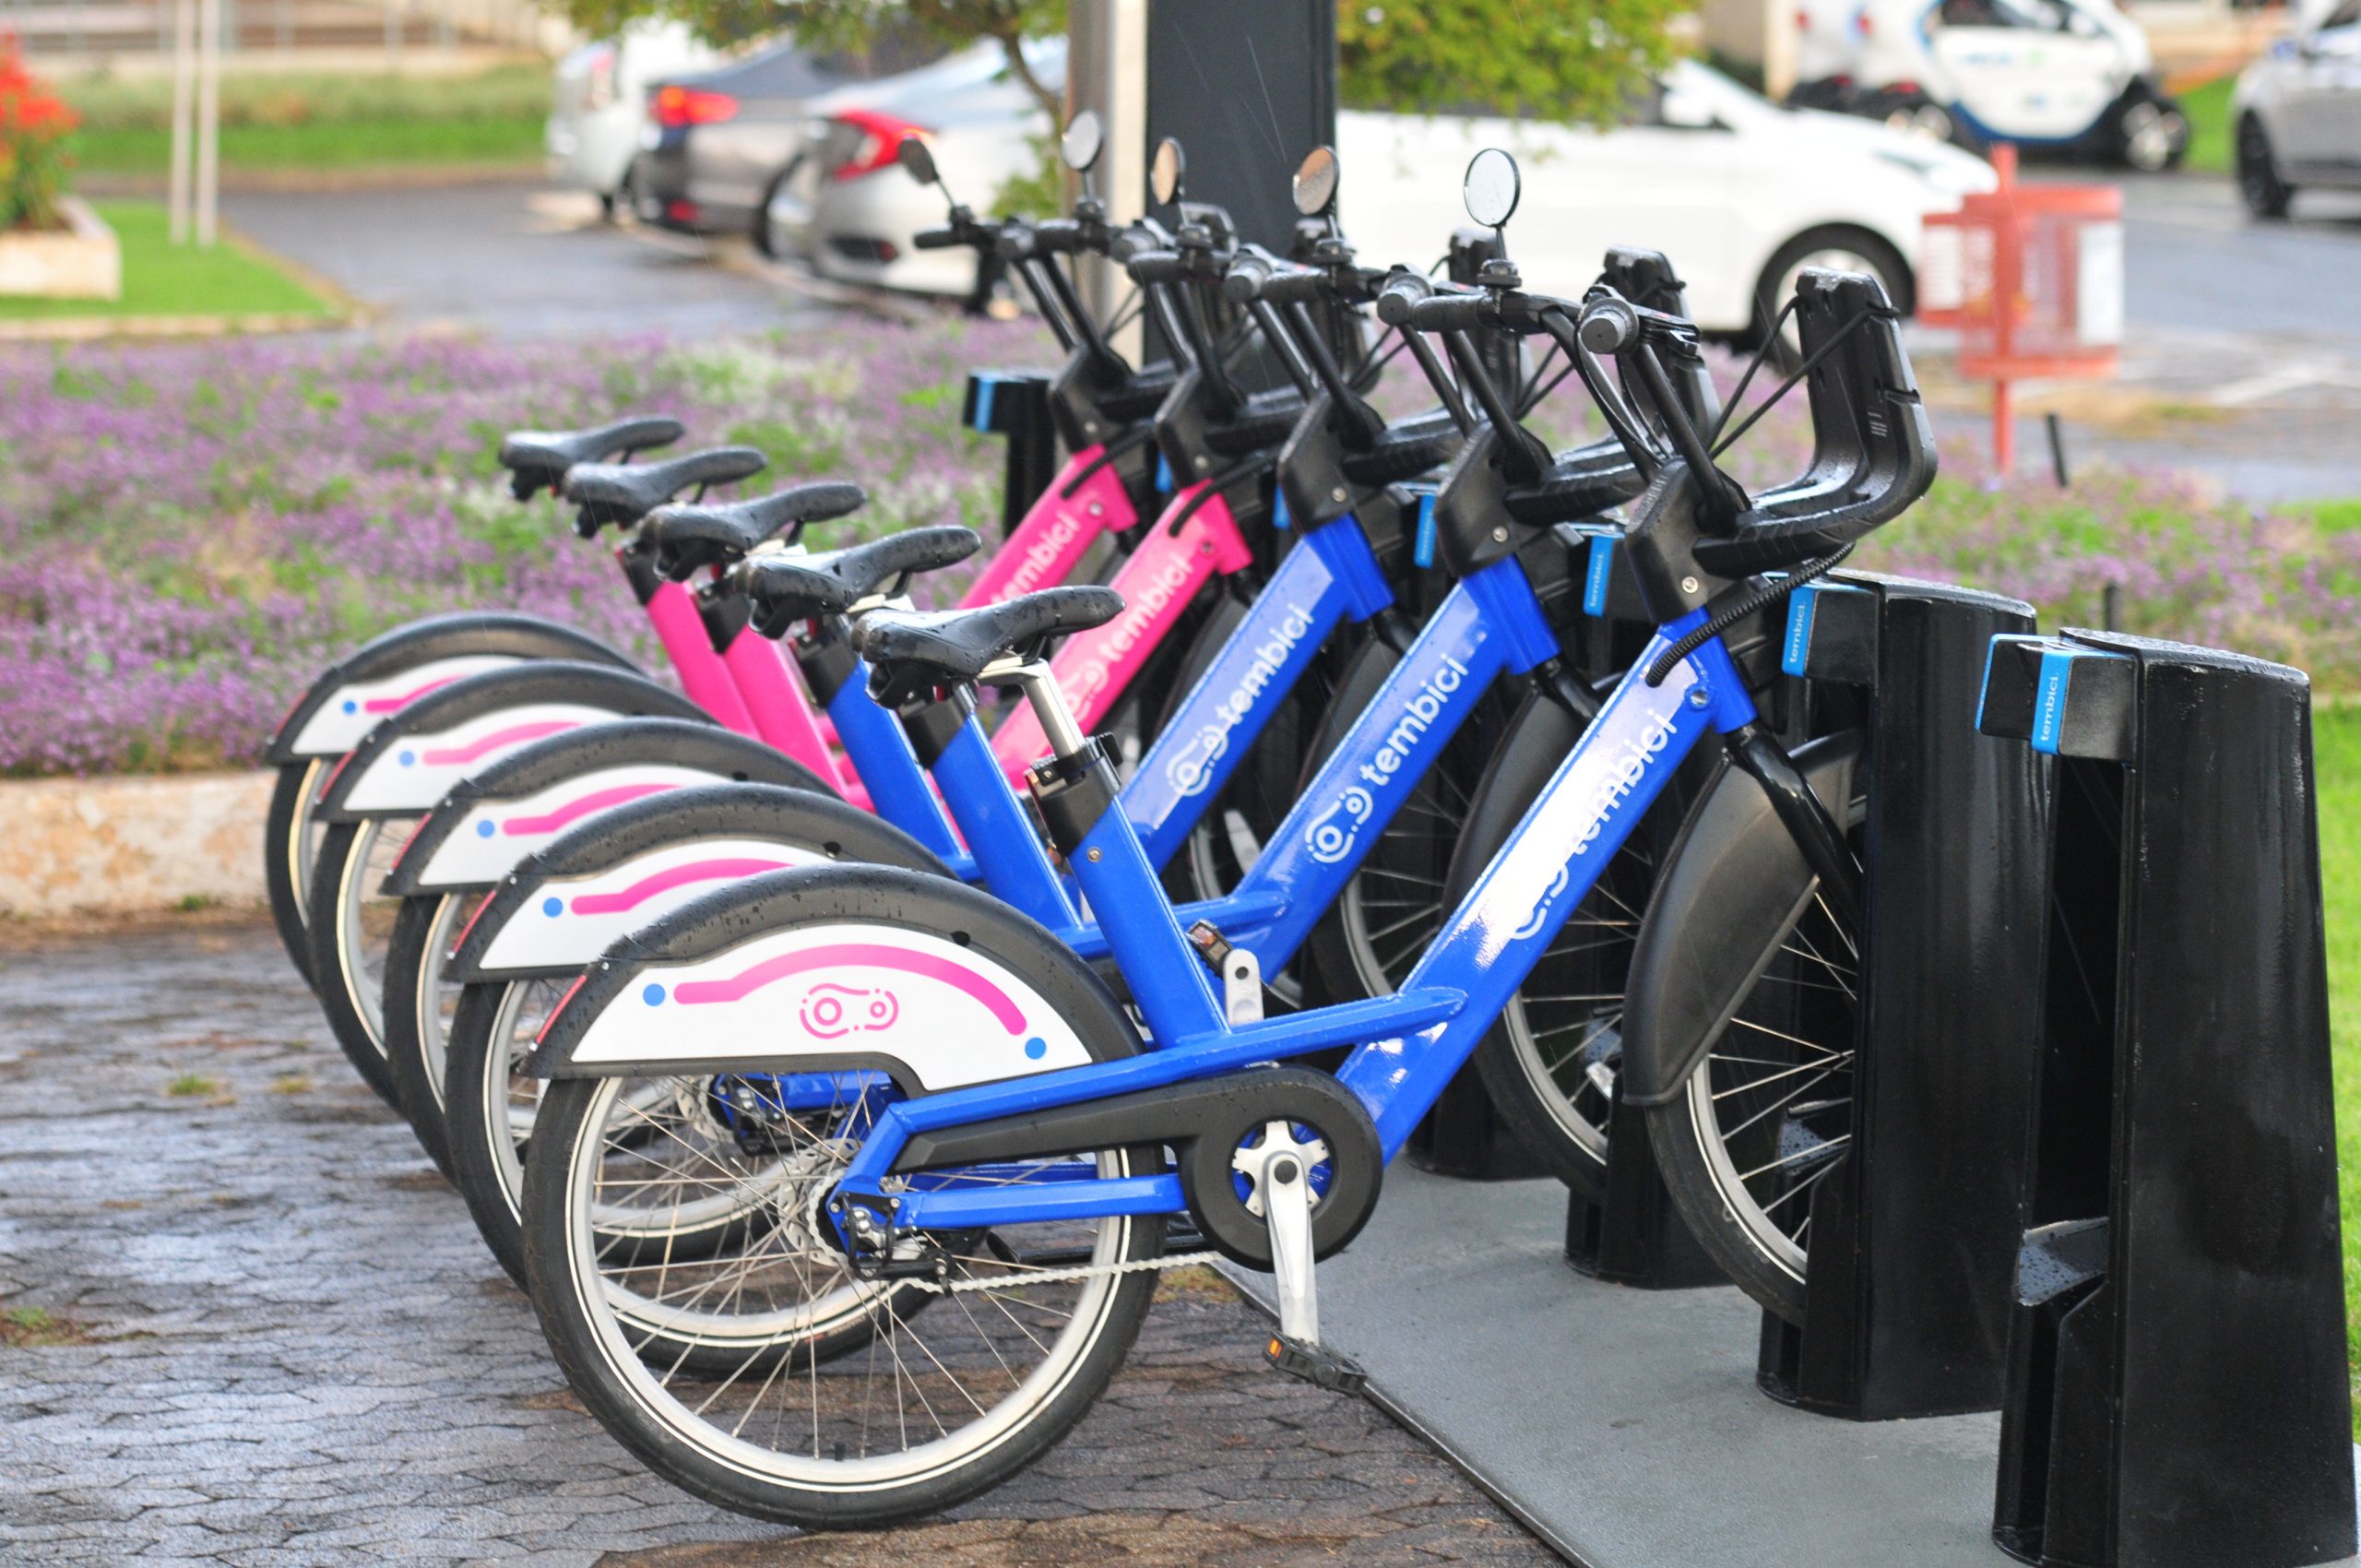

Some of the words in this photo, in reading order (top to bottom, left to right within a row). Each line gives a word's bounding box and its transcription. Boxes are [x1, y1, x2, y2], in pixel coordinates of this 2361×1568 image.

[1098, 552, 1193, 662] tembici
[1215, 603, 1314, 725] tembici
[1358, 652, 1469, 787] tembici
